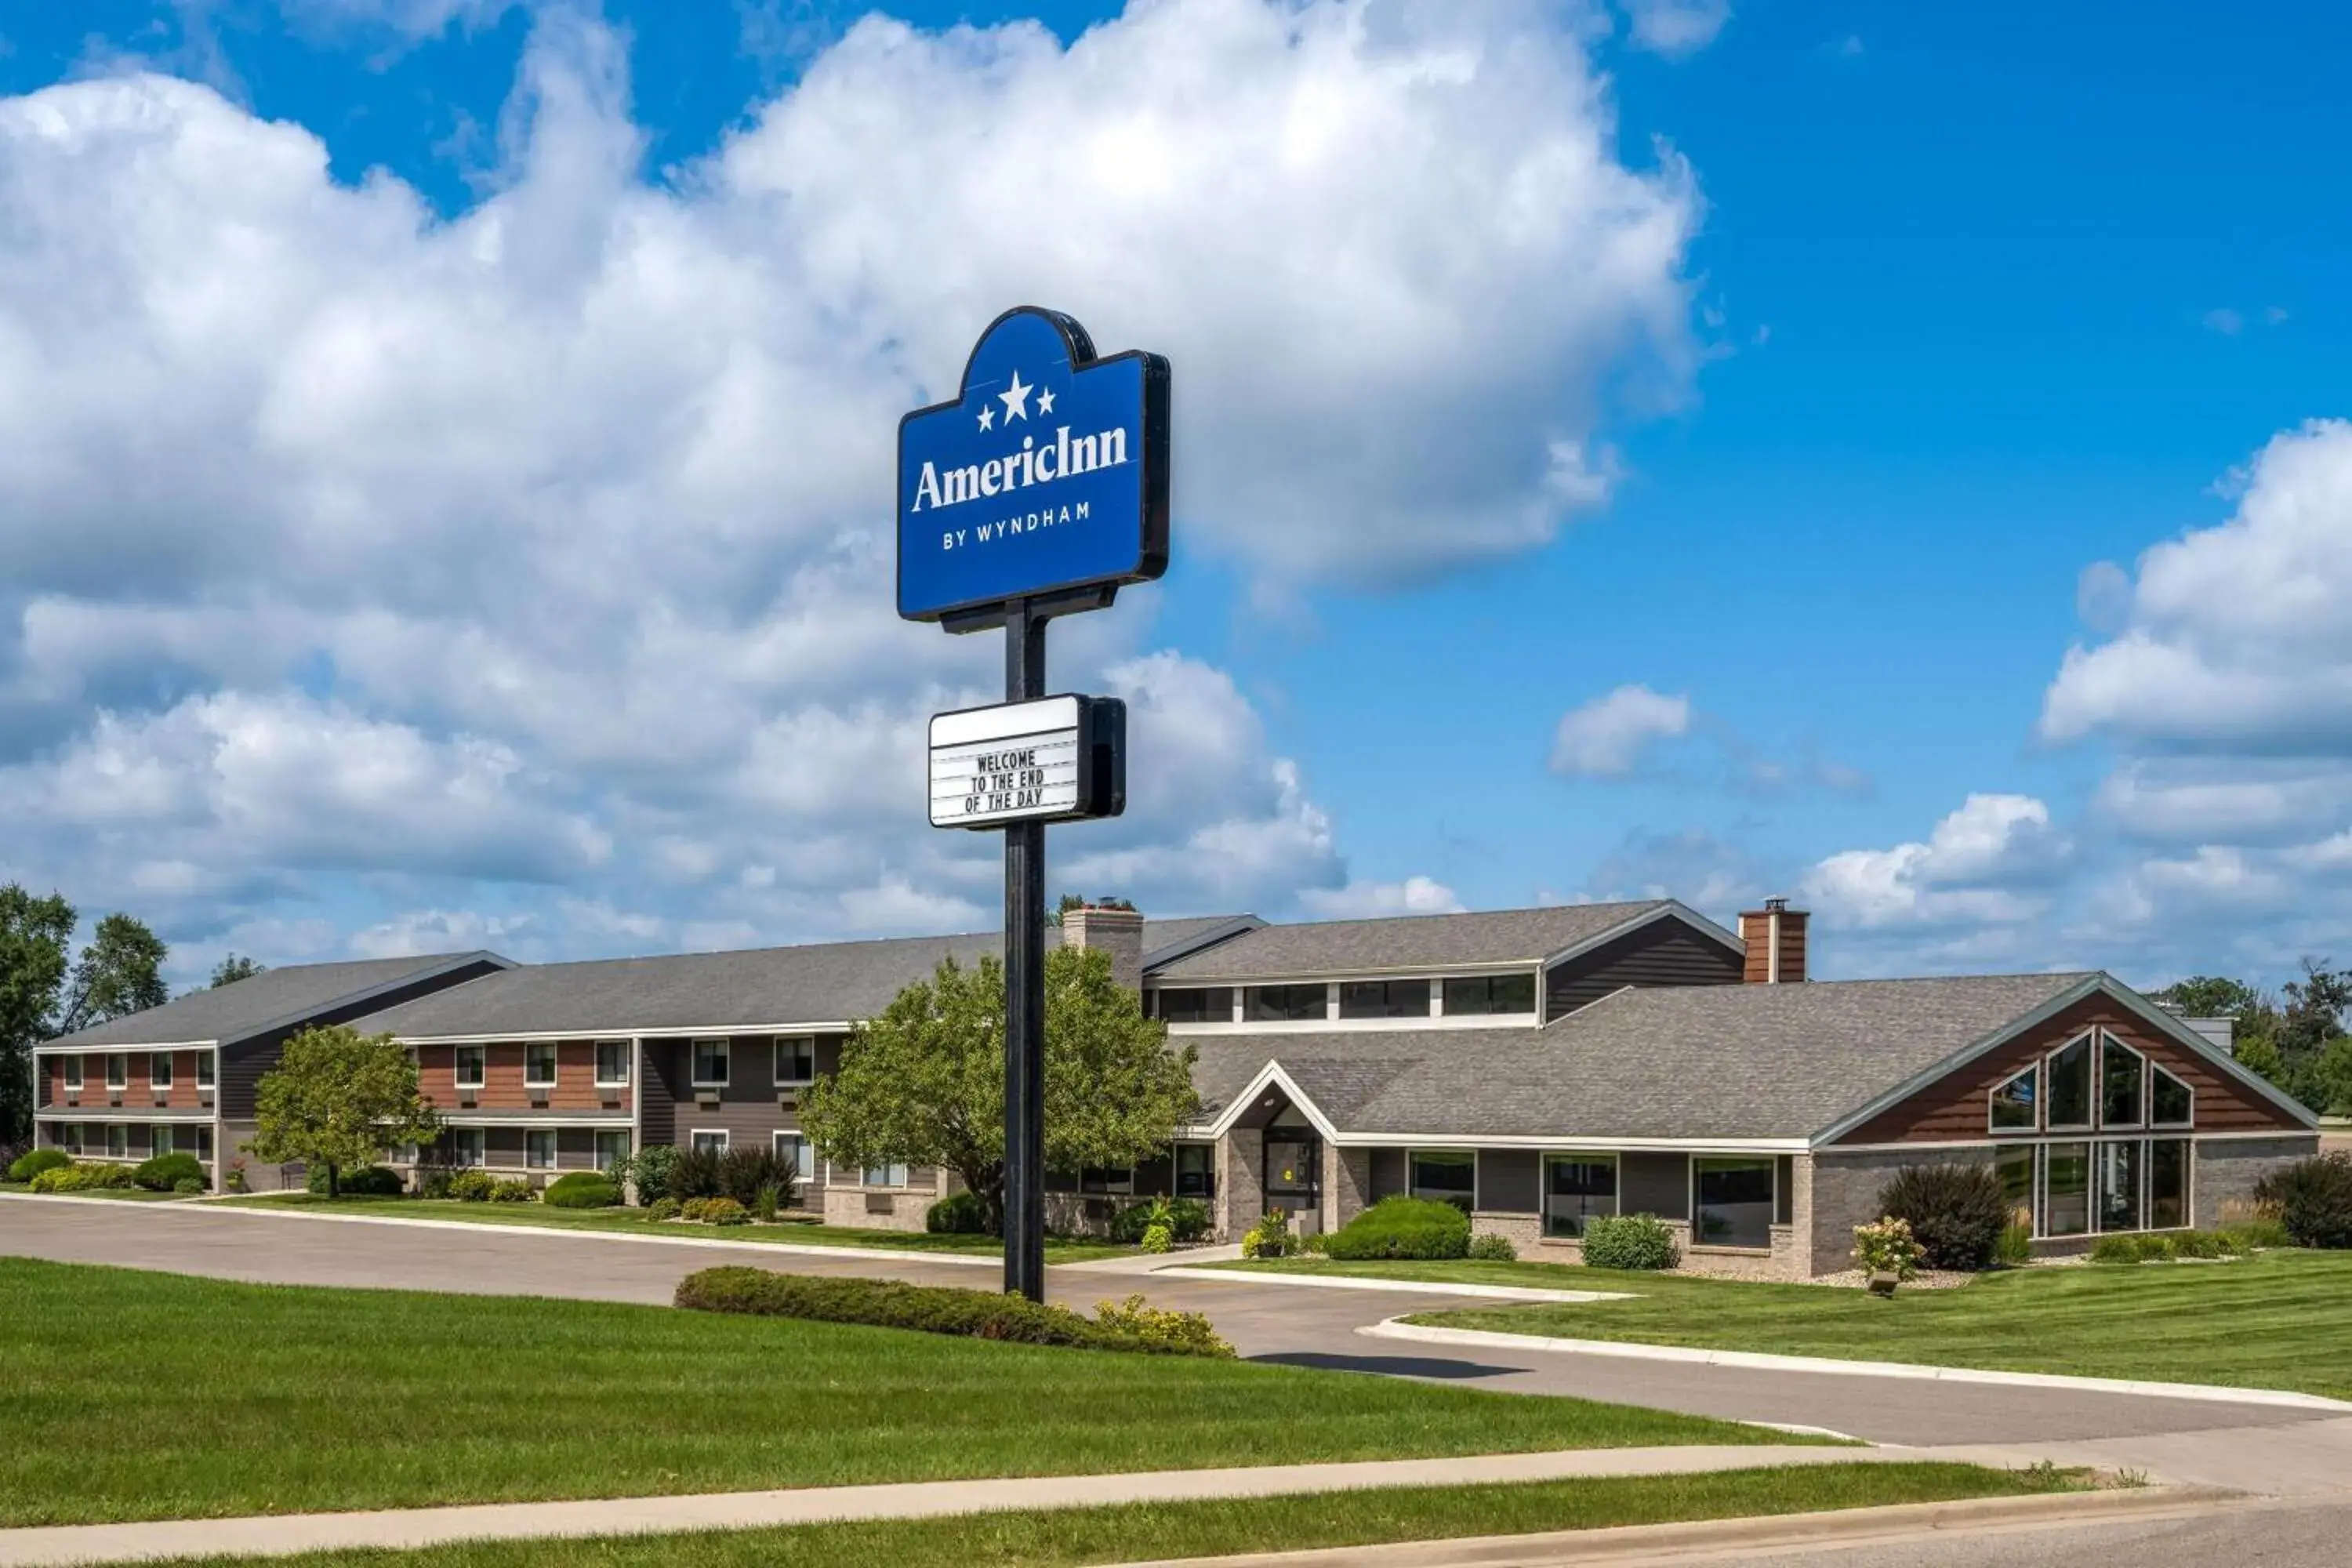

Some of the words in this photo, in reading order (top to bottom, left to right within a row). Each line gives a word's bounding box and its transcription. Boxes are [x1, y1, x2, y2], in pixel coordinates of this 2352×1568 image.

[911, 426, 1128, 512] AmericInn
[943, 529, 967, 550] BY
[977, 501, 1090, 543] WYNDHAM
[978, 750, 1036, 772] WELCOME
[971, 775, 986, 793] TO
[992, 773, 1014, 790] THE
[1021, 769, 1044, 787] END
[965, 796, 979, 812] OF
[989, 793, 1011, 810] THE
[1018, 789, 1043, 807] DAY
